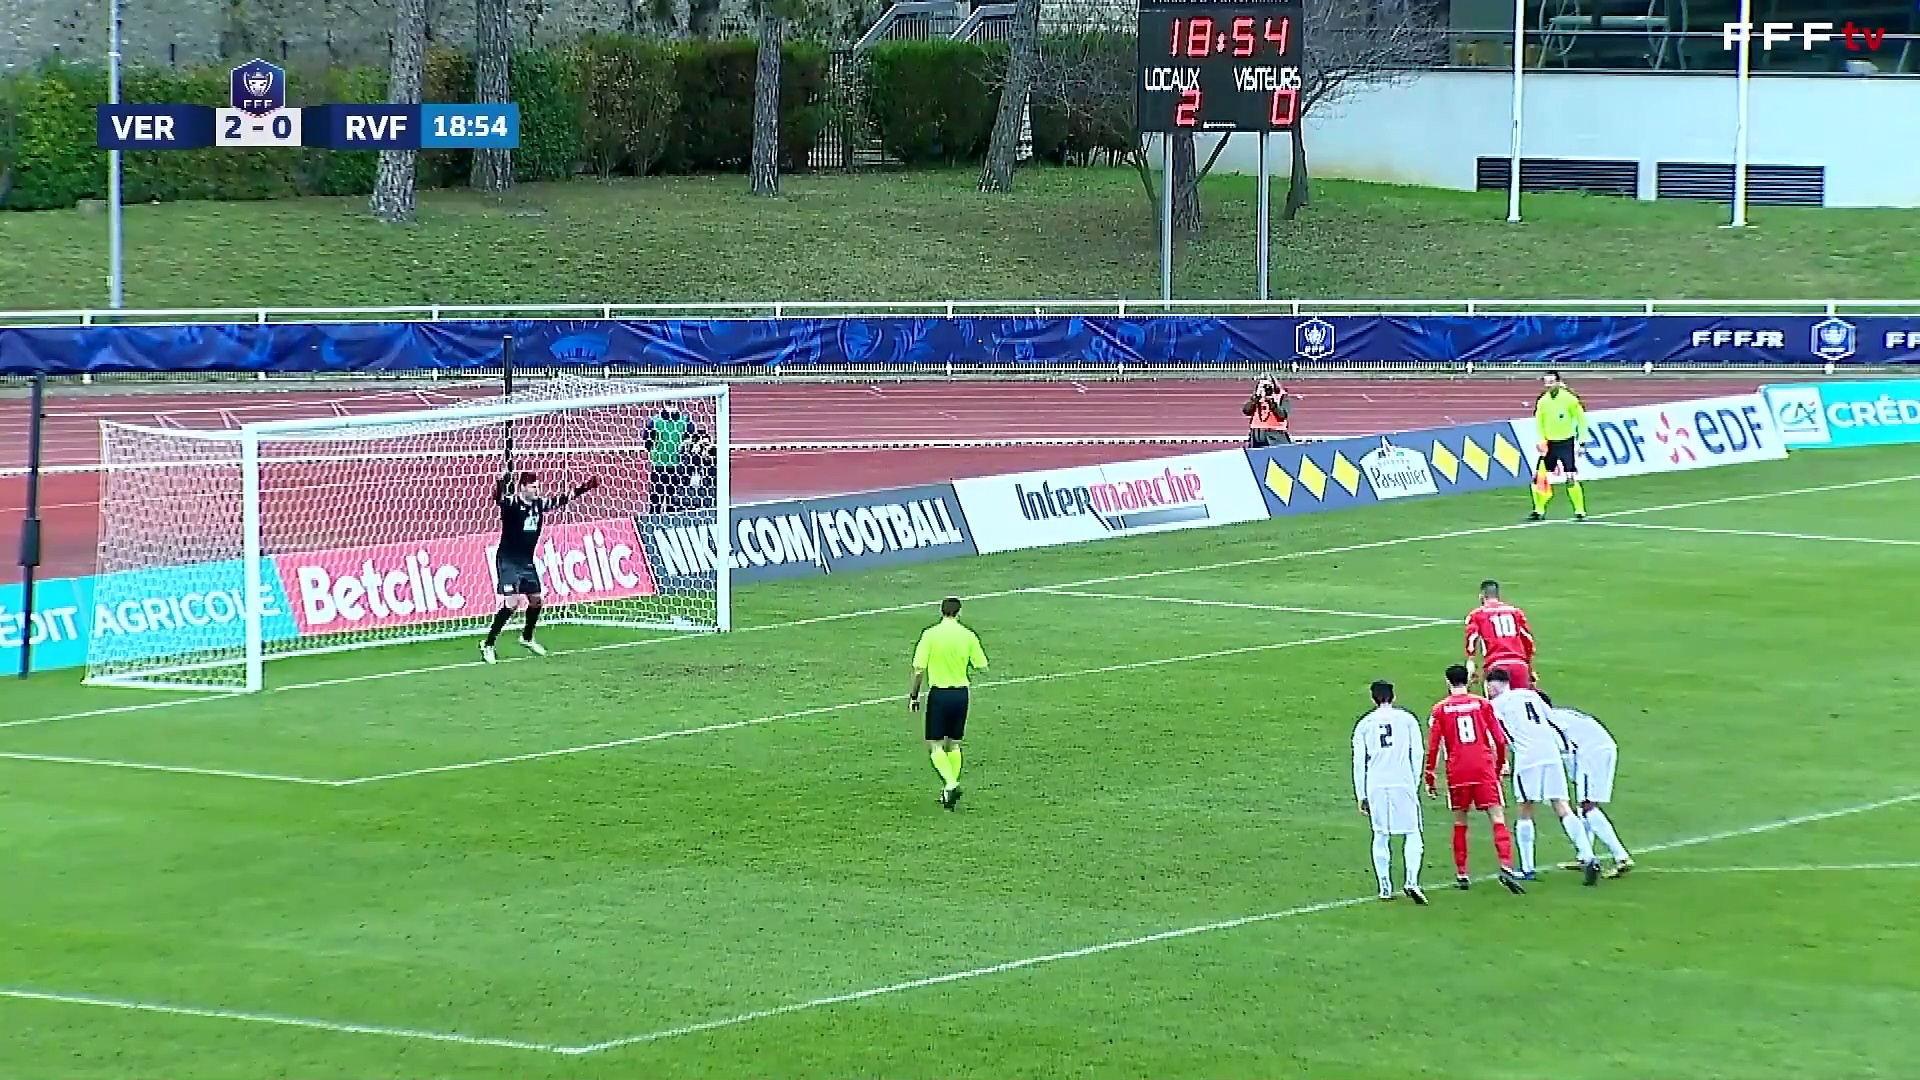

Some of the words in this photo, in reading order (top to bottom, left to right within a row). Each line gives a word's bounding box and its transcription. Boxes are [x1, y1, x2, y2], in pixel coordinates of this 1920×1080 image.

[1171, 16, 1290, 58] 18:54
[1144, 66, 1201, 91] LOCAUX
[1233, 66, 1301, 92] VISITEURS
[1176, 88, 1203, 127] 2
[1270, 88, 1298, 127] 0
[1369, 466, 1428, 491] Pasquier
[653, 497, 964, 576] NIK.COM/FOOTBALL
[297, 550, 467, 625] Betclic
[1489, 613, 1517, 637] 10
[1525, 701, 1541, 724] 4
[1379, 723, 1393, 748] 2
[1457, 715, 1476, 743] 8
